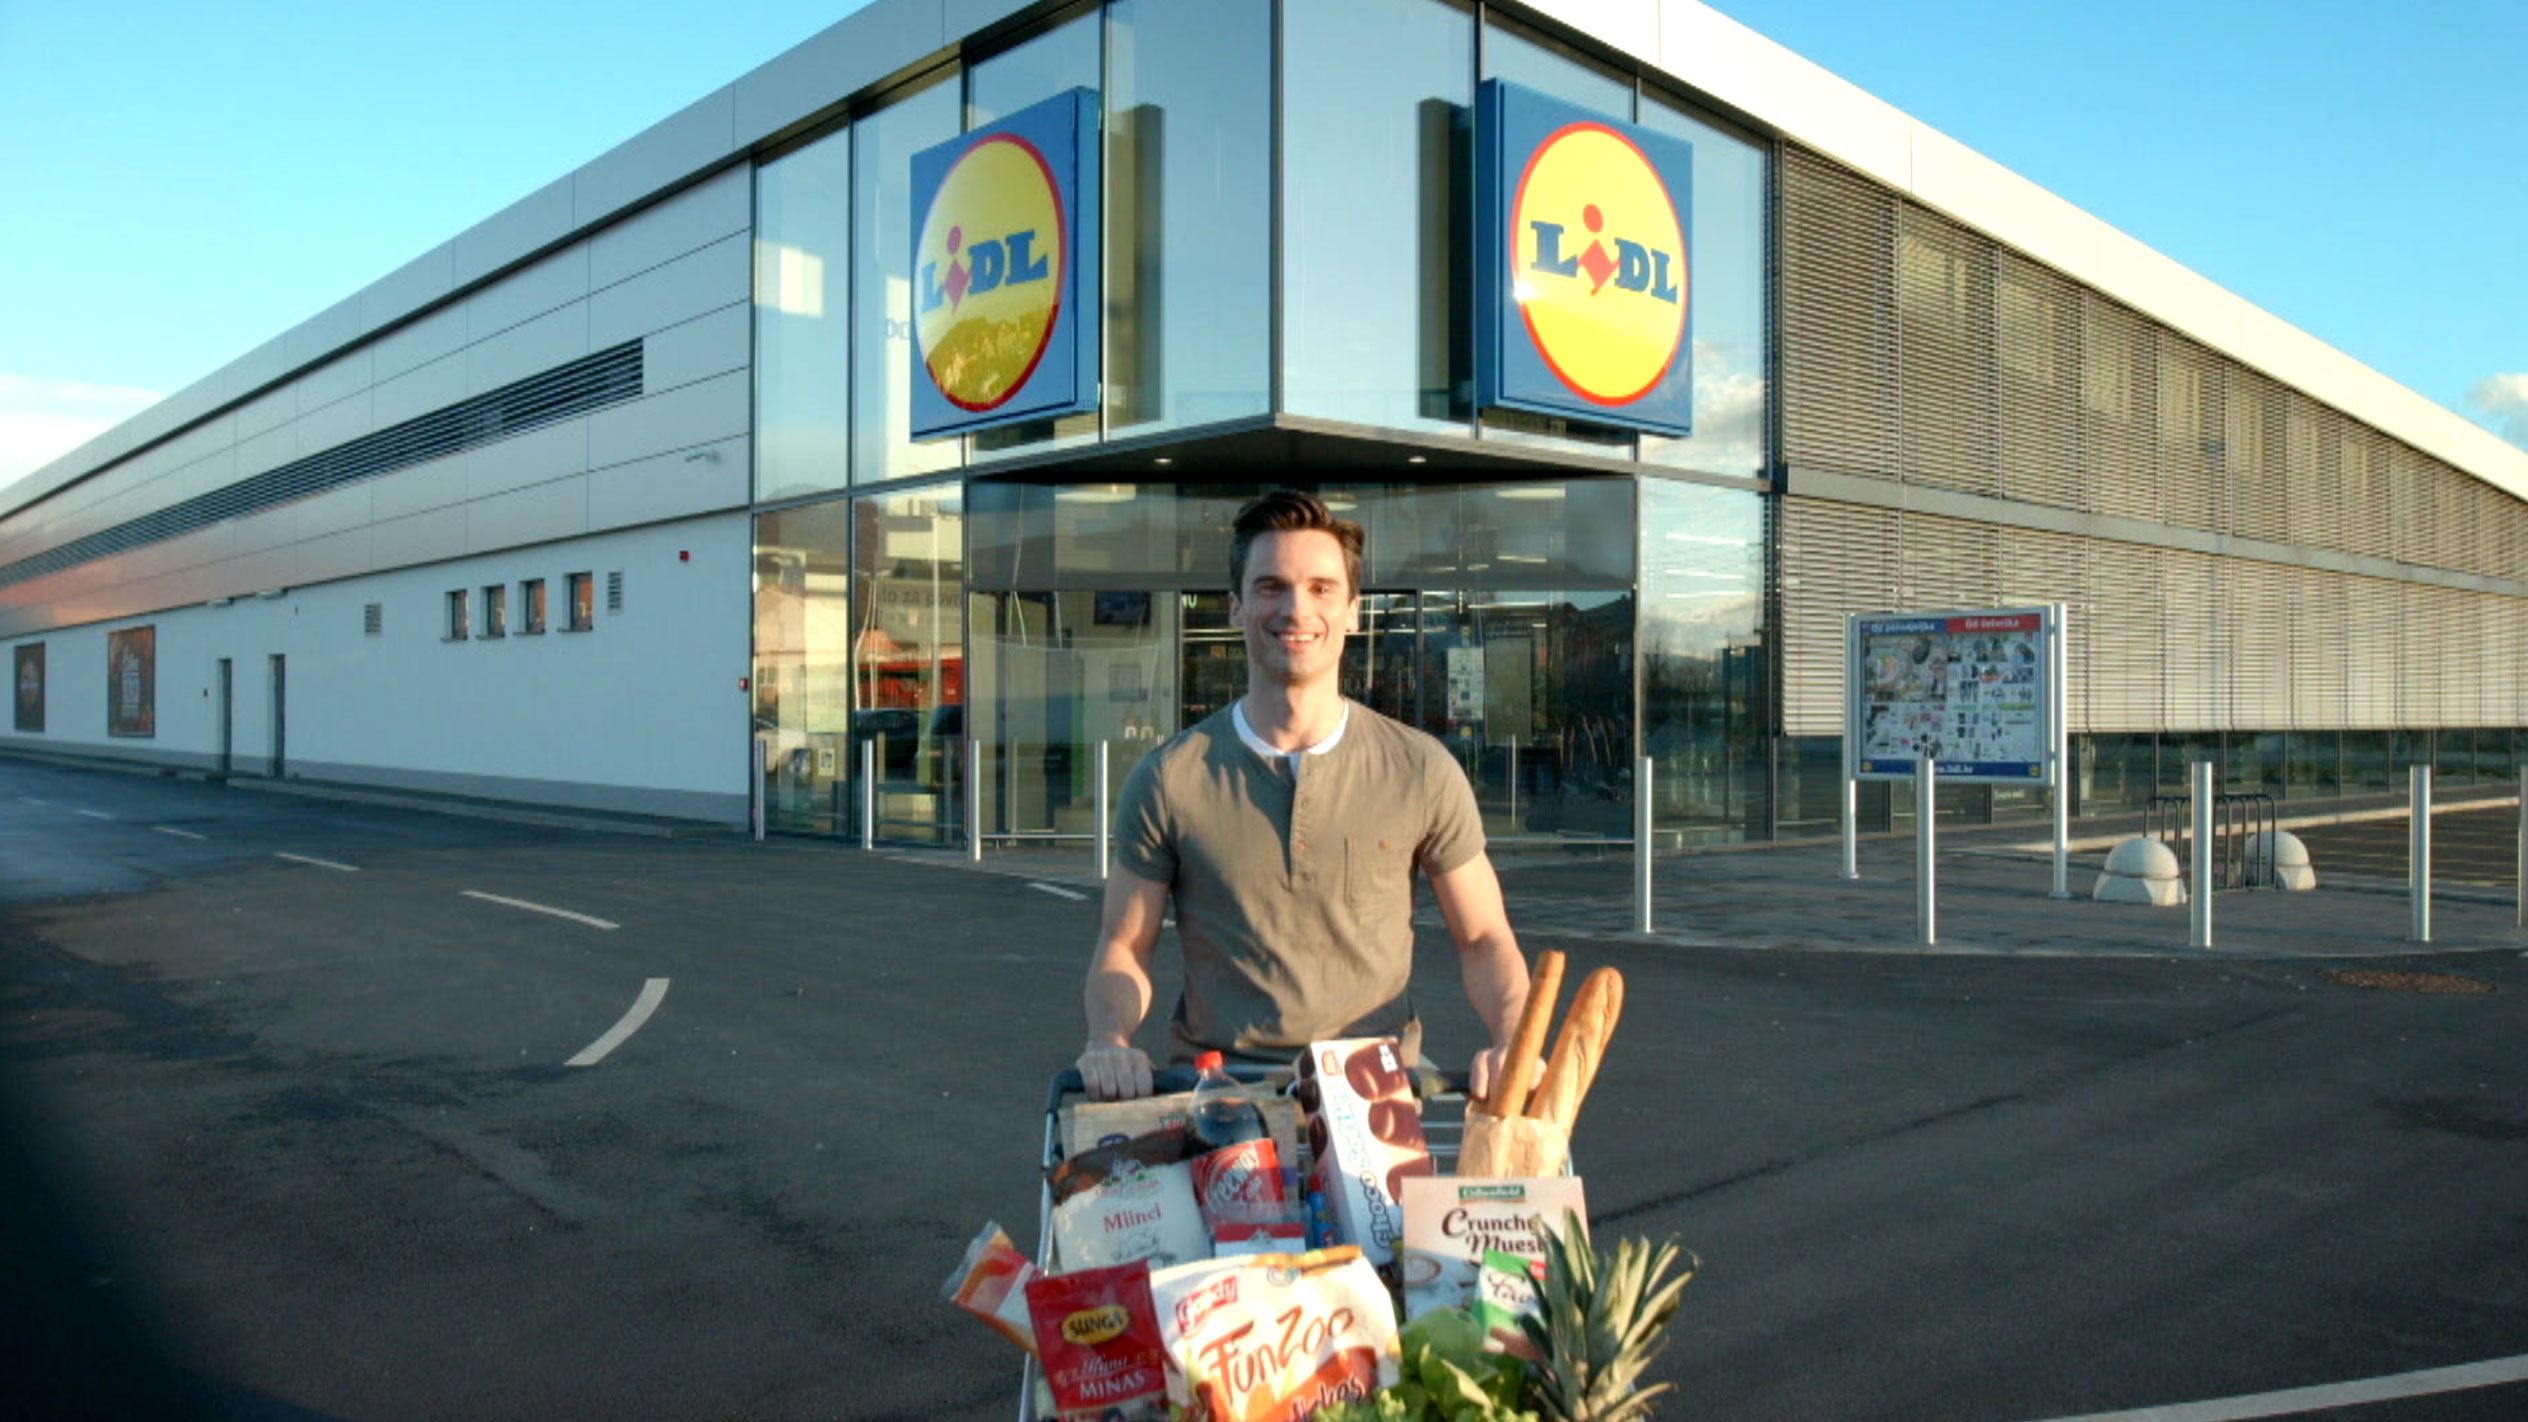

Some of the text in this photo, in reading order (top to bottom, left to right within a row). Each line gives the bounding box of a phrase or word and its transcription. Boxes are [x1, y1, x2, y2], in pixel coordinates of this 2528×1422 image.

[1359, 1170, 1394, 1249] Choco
[1466, 1234, 1545, 1254] Muesl
[1079, 1371, 1146, 1399] MINAS
